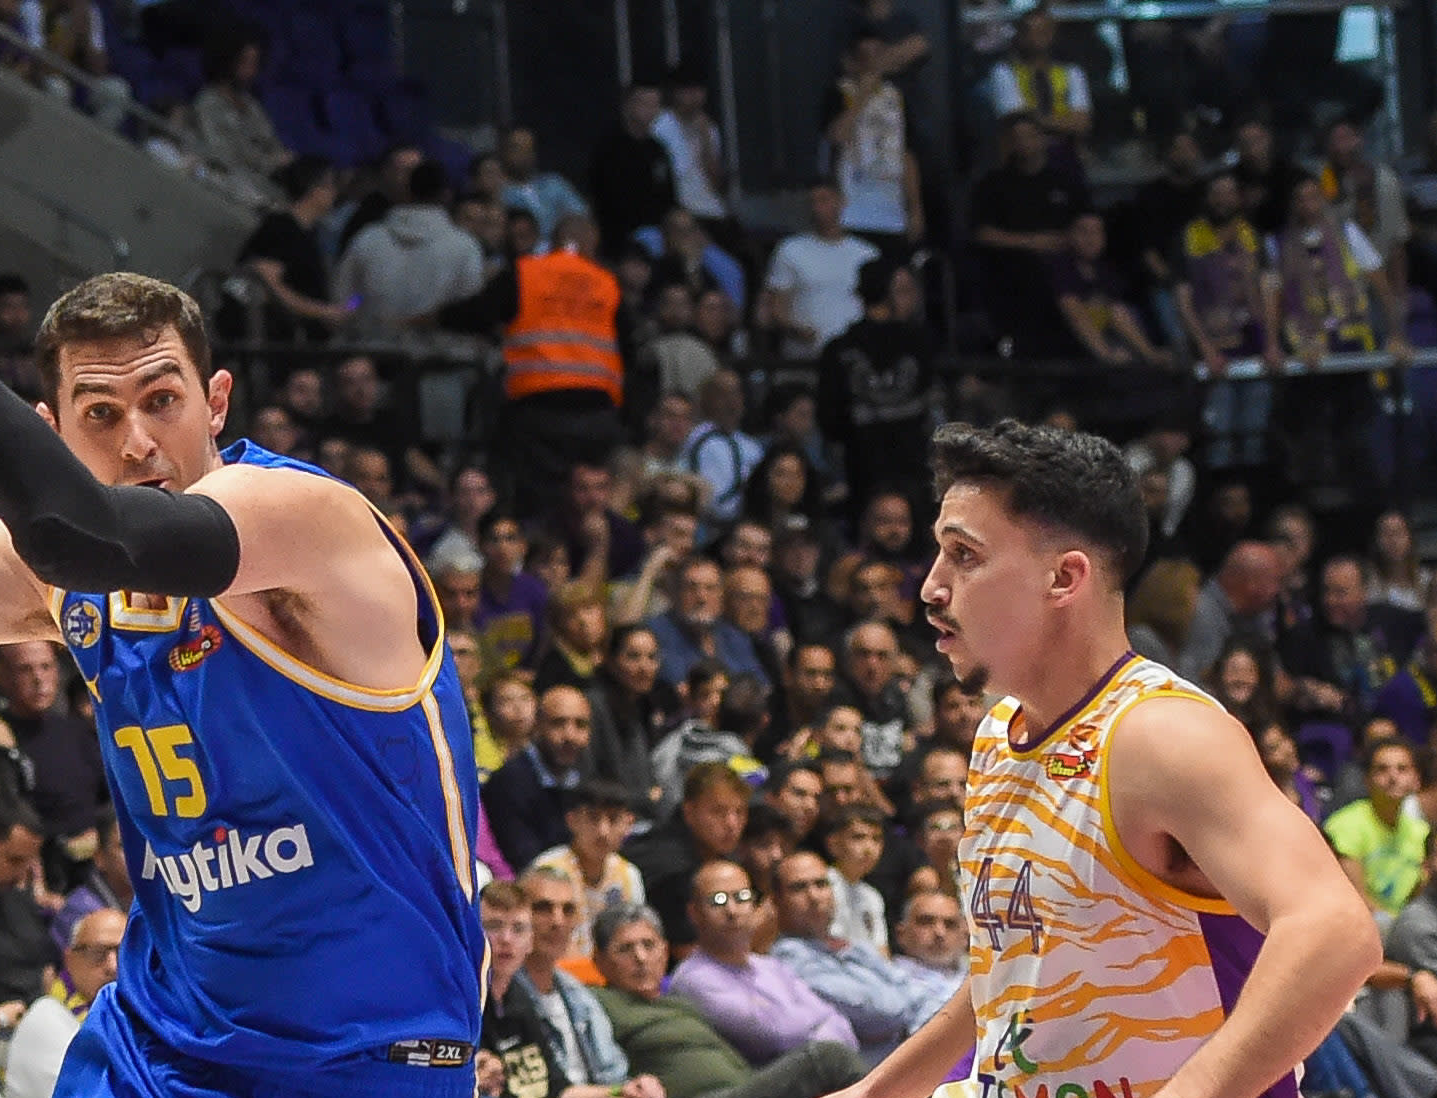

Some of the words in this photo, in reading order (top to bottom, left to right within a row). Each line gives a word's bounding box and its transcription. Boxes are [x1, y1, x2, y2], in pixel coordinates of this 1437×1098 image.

[114, 723, 208, 819] 15
[141, 823, 315, 914] ytika
[970, 857, 1044, 955] 44
[436, 1044, 463, 1061] 2XL
